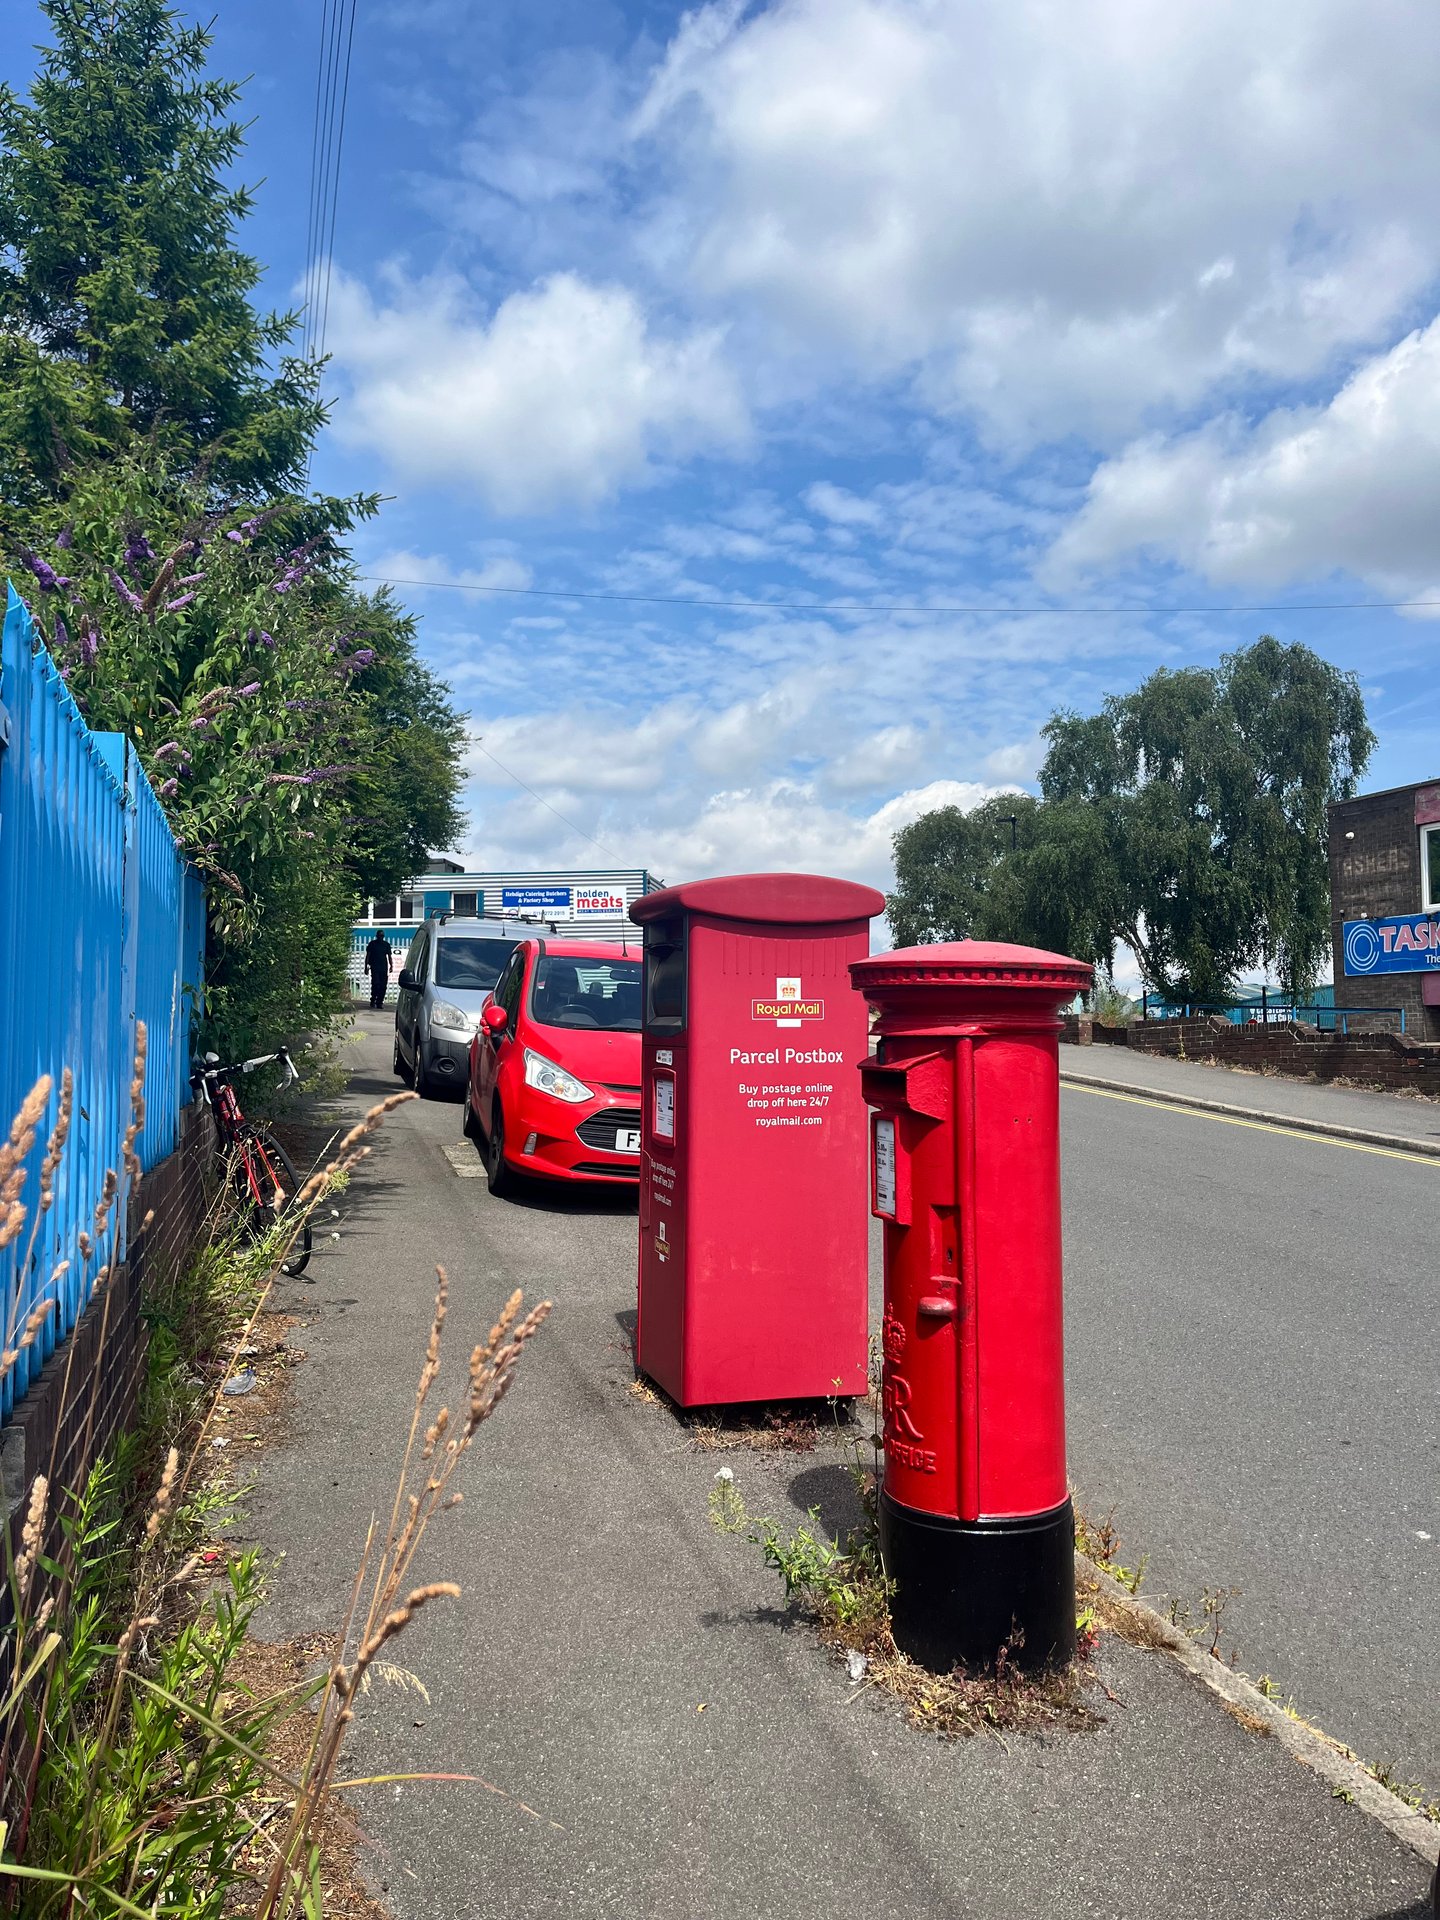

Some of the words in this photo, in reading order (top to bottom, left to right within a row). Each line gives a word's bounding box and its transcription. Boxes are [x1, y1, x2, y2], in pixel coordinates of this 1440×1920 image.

[577, 890, 609, 898] holden
[577, 896, 623, 908] meats
[756, 1003, 791, 1017] Royal
[794, 1003, 820, 1015] Mail
[730, 1048, 779, 1064] Parcel
[785, 1048, 843, 1064] Postbox
[738, 1083, 758, 1095] Buy
[762, 1084, 801, 1095] postage
[805, 1083, 833, 1093] online
[747, 1098, 769, 1109] drop
[771, 1097, 785, 1107] off
[787, 1097, 807, 1107] here
[809, 1096, 829, 1106] 24/7
[755, 1116, 822, 1128] royalmail.com
